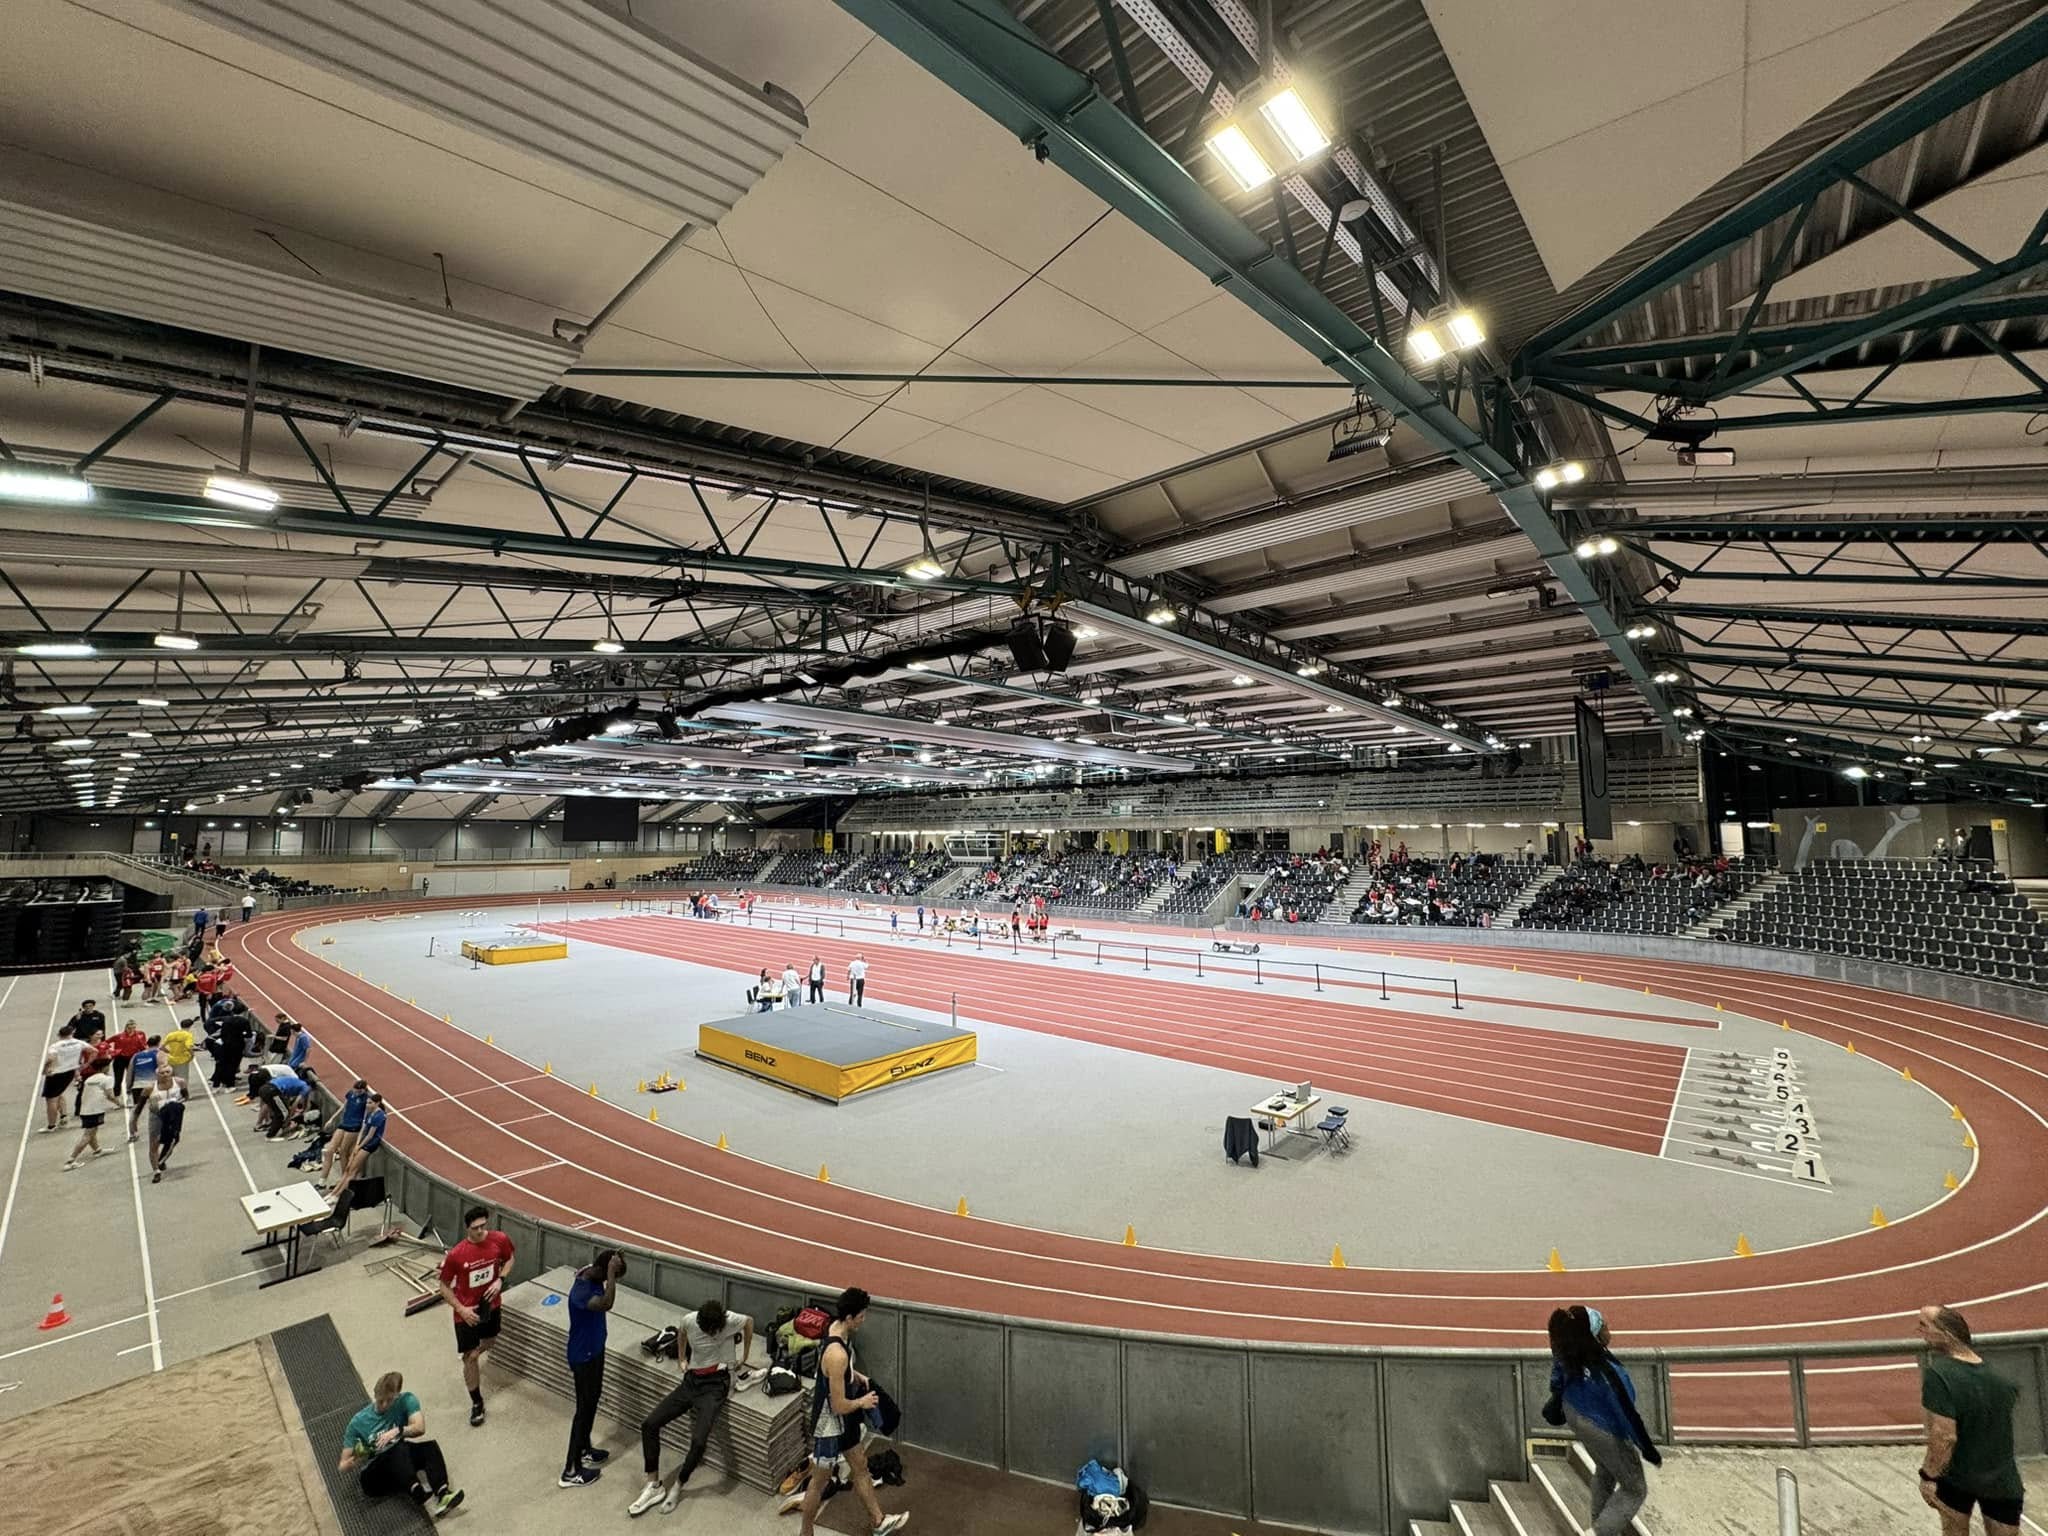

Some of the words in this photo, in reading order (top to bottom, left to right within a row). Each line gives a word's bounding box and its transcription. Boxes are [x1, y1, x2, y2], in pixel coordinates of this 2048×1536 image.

[744, 1049, 777, 1067] BENZ
[1776, 1086, 1789, 1100] 5
[1795, 1118, 1810, 1134] 3
[1784, 1134, 1799, 1151] 2
[1804, 1159, 1815, 1177] 1
[474, 1271, 490, 1282] 247
